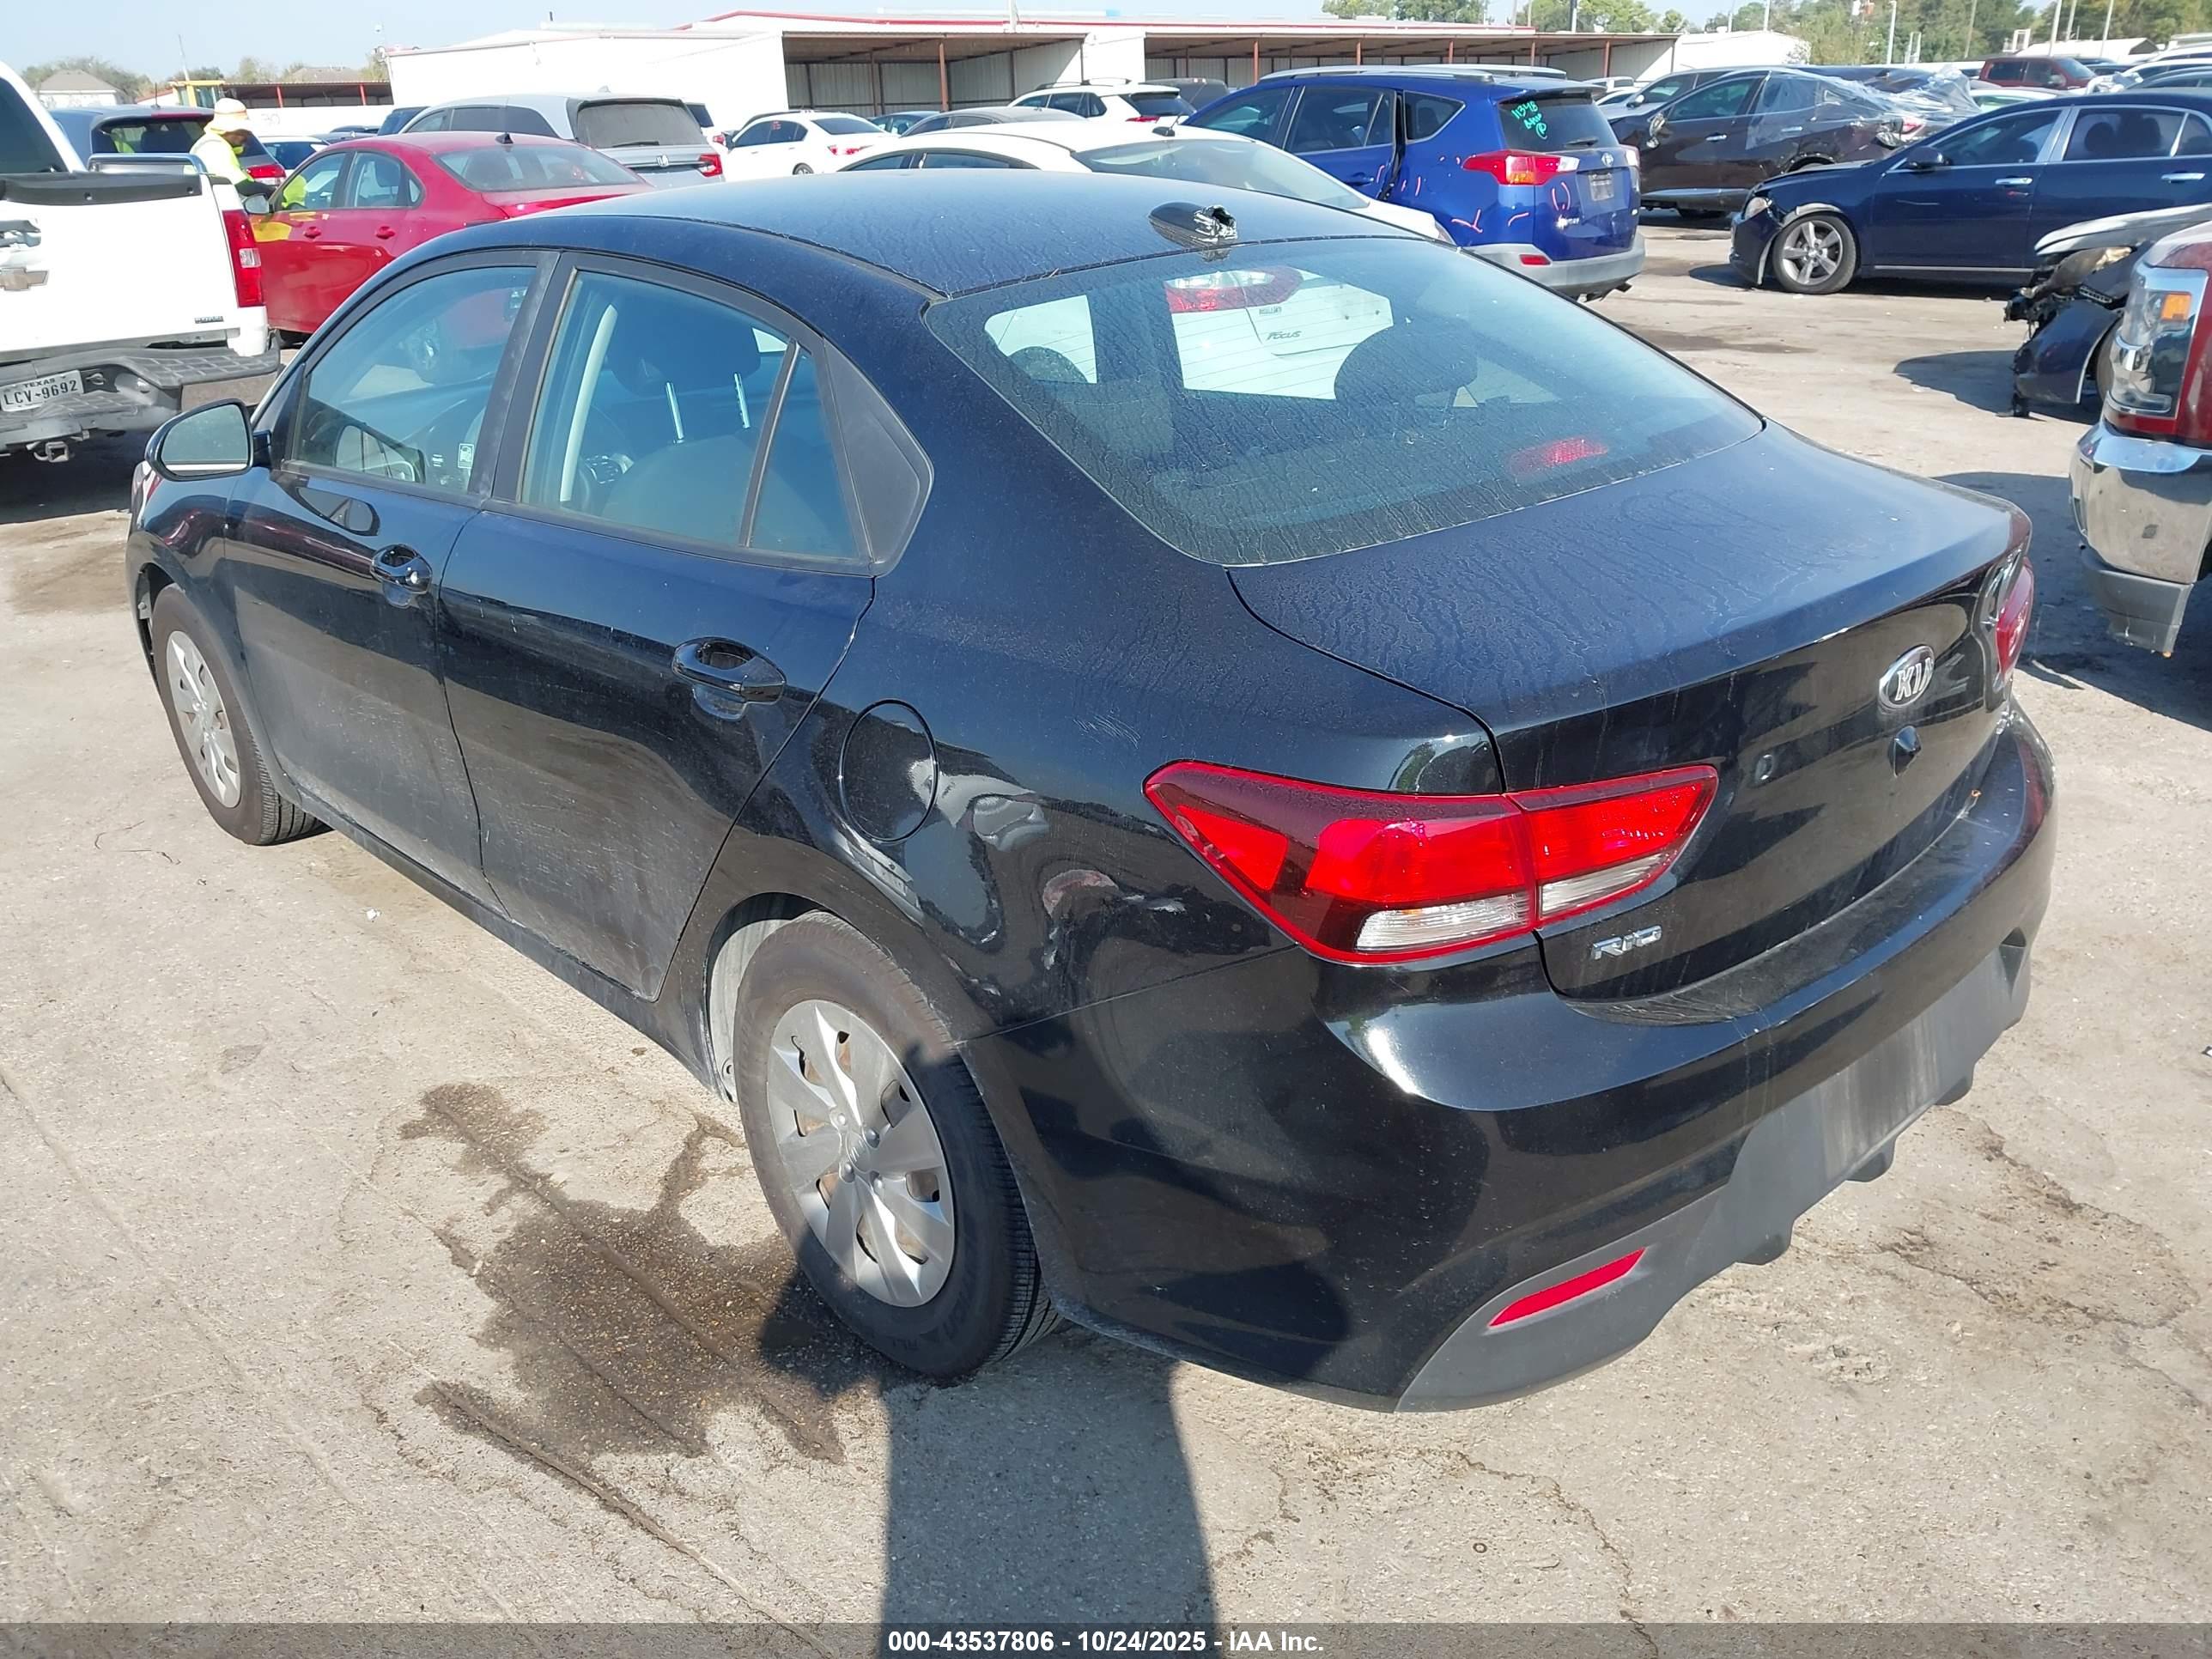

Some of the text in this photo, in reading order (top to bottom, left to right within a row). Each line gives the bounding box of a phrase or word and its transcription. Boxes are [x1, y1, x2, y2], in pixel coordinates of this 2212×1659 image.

[24, 378, 56, 388] TEXAS
[1894, 657, 1933, 701] KIA
[1593, 925, 1662, 960] RIO
